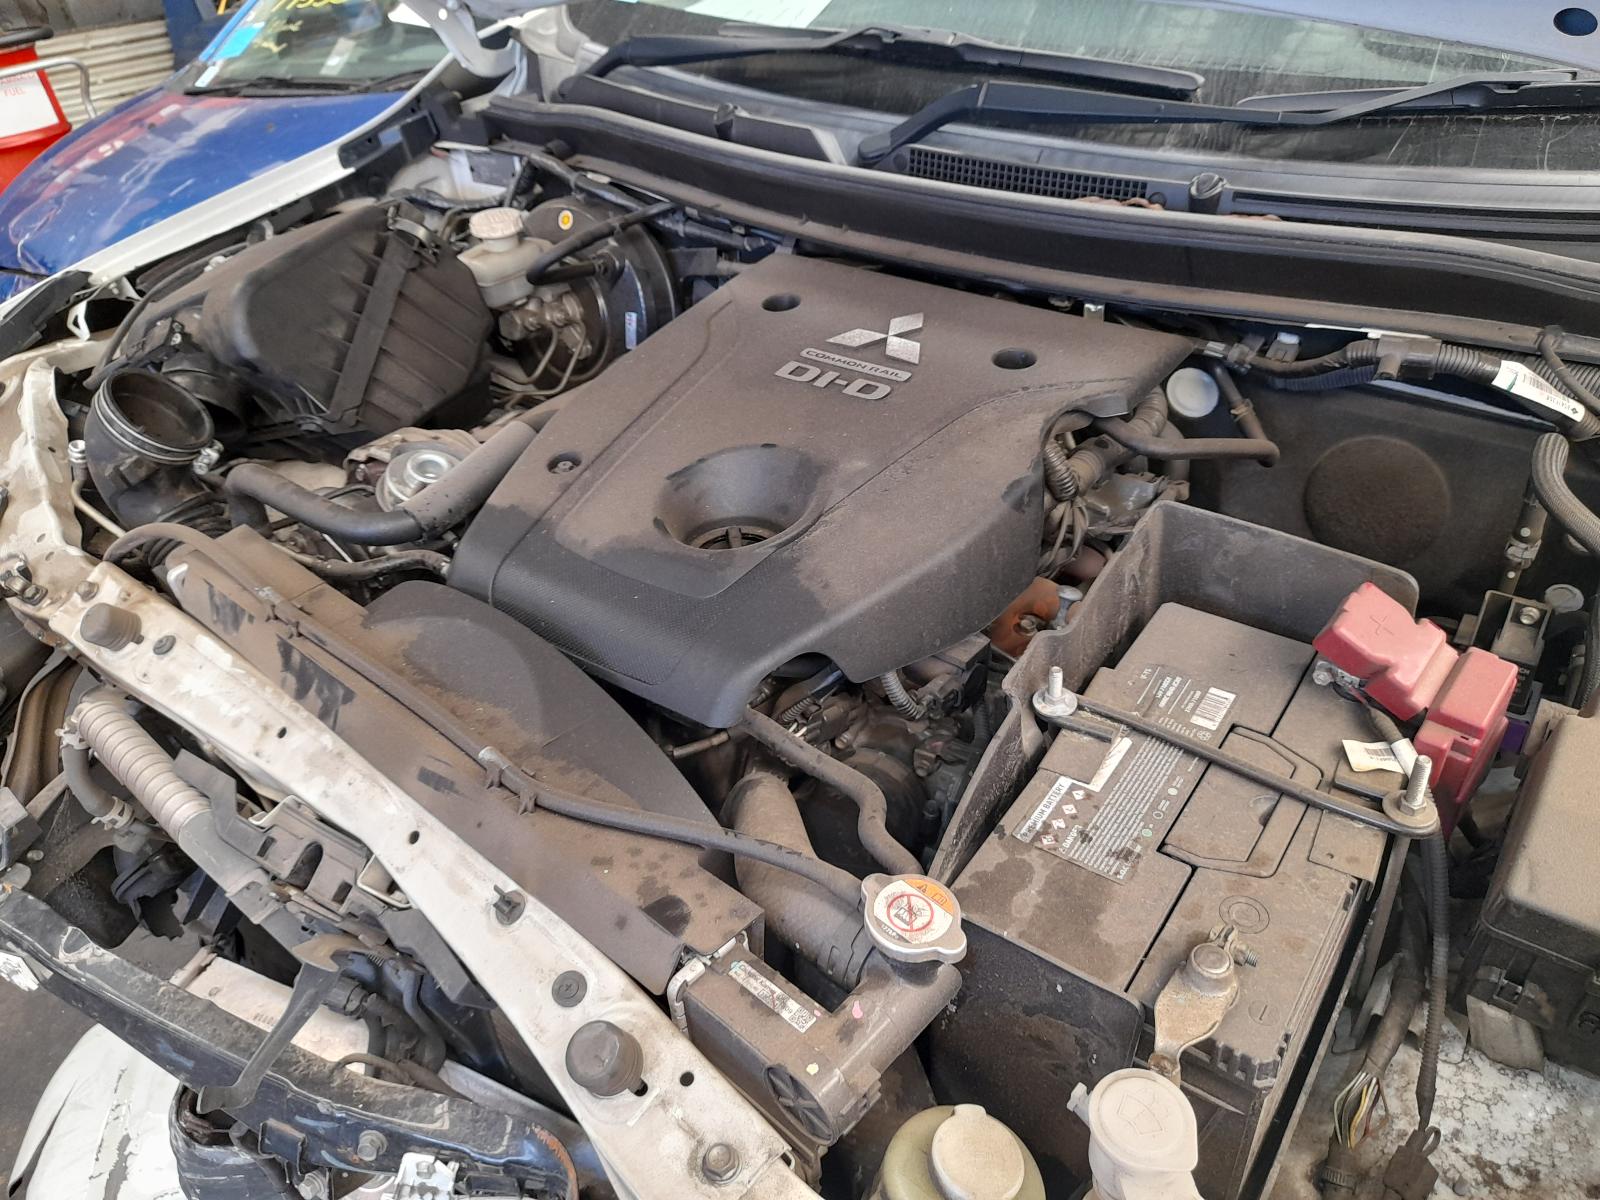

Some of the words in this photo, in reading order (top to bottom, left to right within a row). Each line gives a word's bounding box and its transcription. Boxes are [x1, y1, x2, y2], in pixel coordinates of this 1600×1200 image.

[805, 349, 867, 370] COMMON
[869, 365, 904, 379] RAIL
[774, 360, 892, 400] DI-D
[1043, 783, 1065, 810] BATTERY
